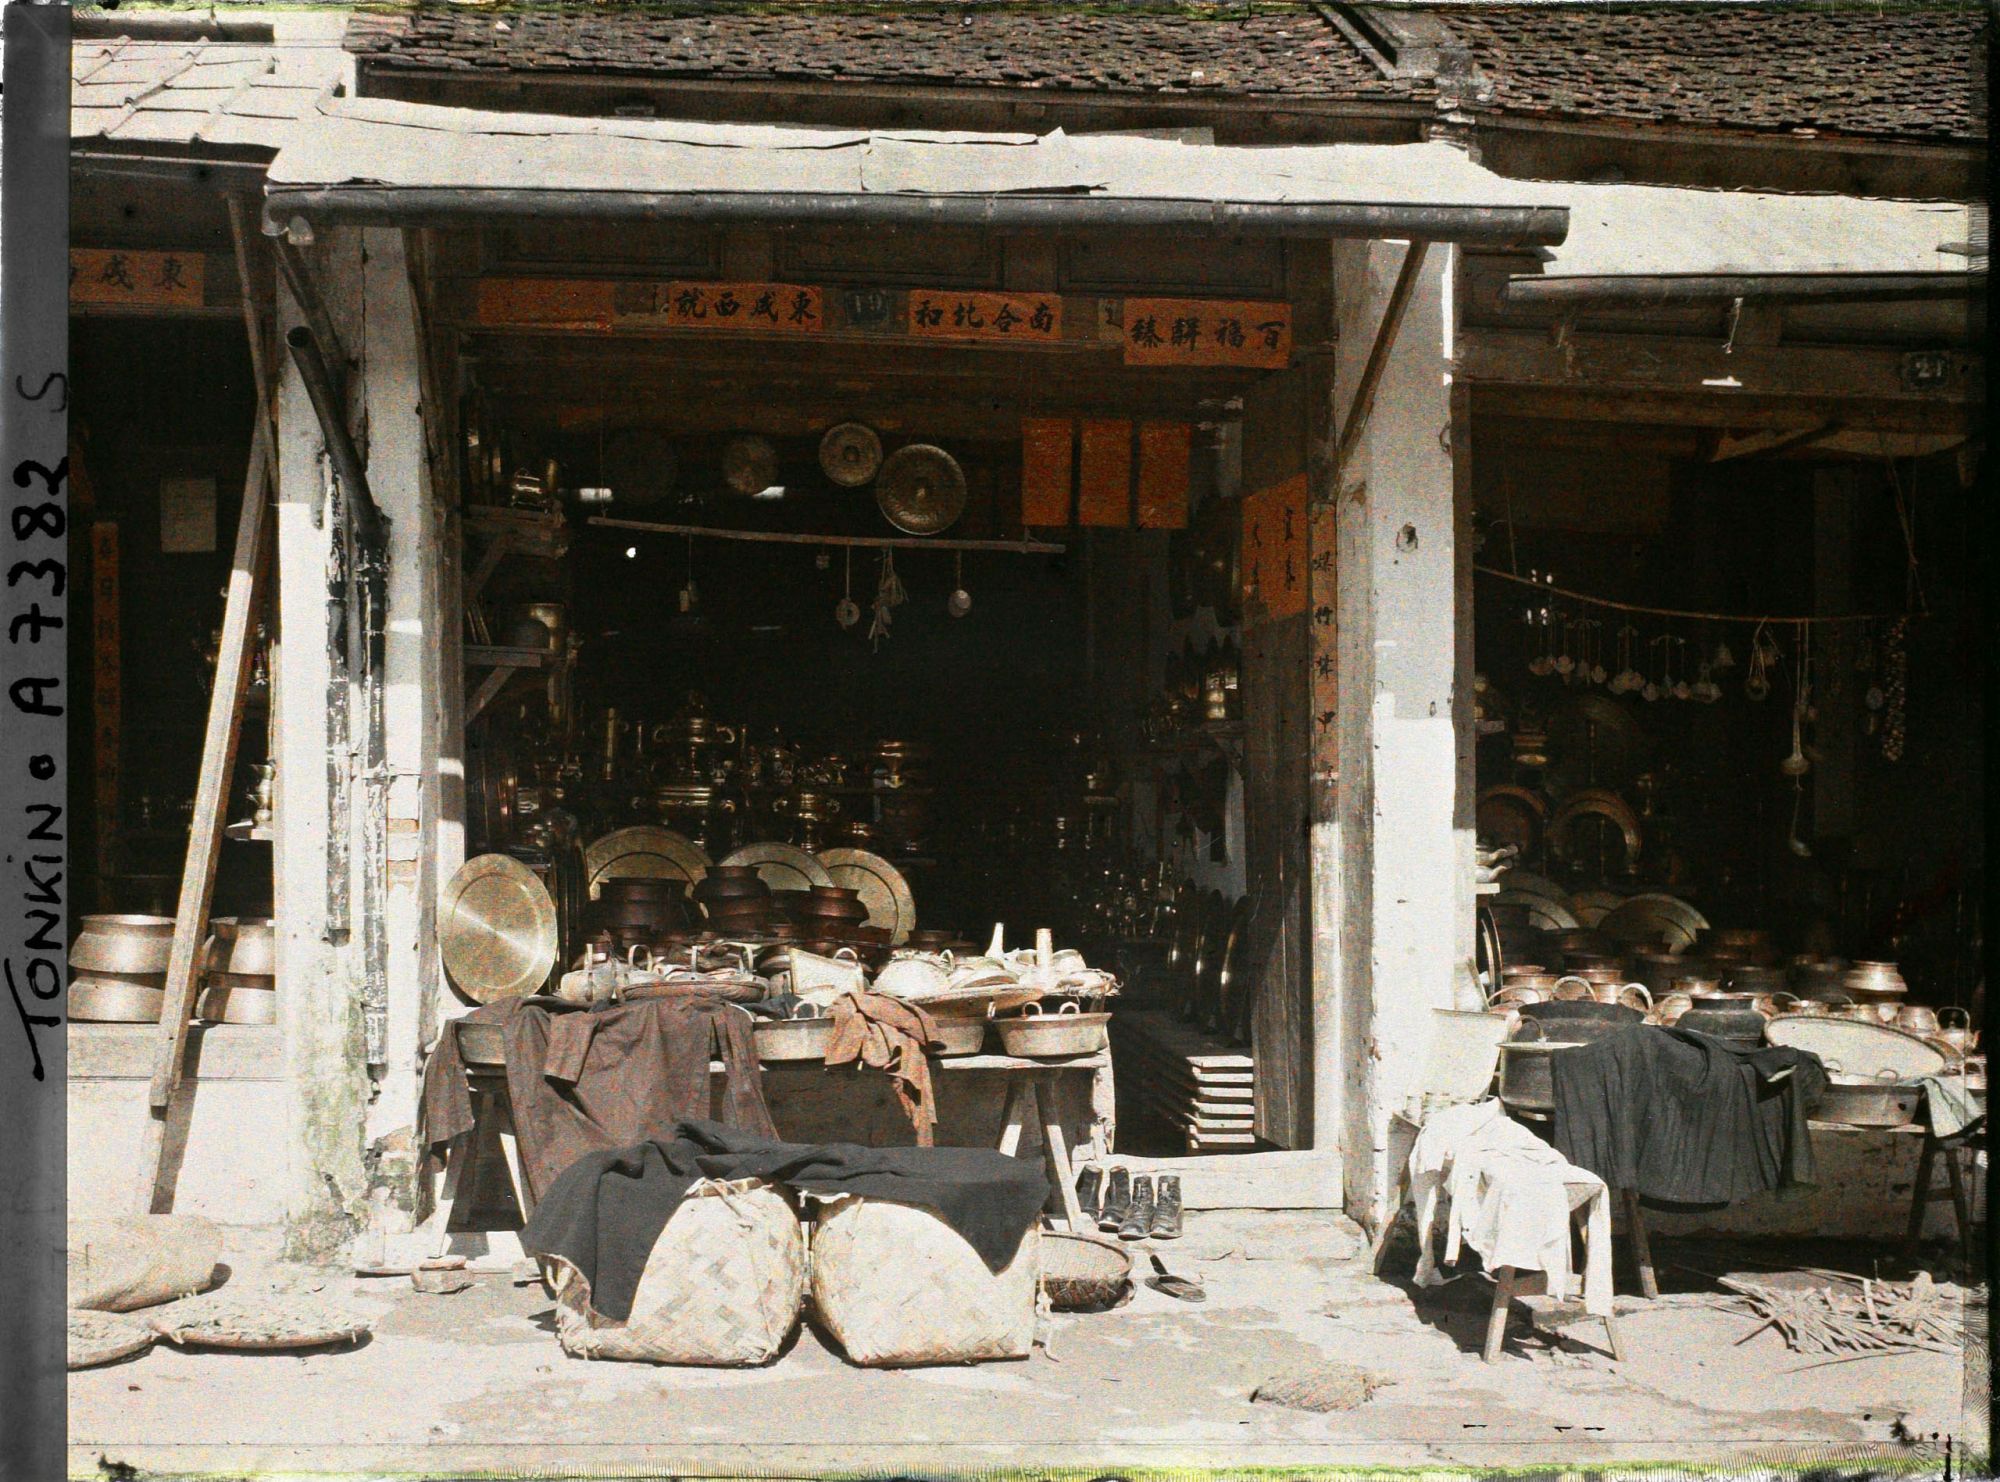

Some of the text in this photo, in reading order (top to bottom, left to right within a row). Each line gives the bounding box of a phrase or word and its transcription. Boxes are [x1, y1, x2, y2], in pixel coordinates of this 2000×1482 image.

[69, 254, 188, 291] 東成
[673, 287, 817, 324] 東成西就
